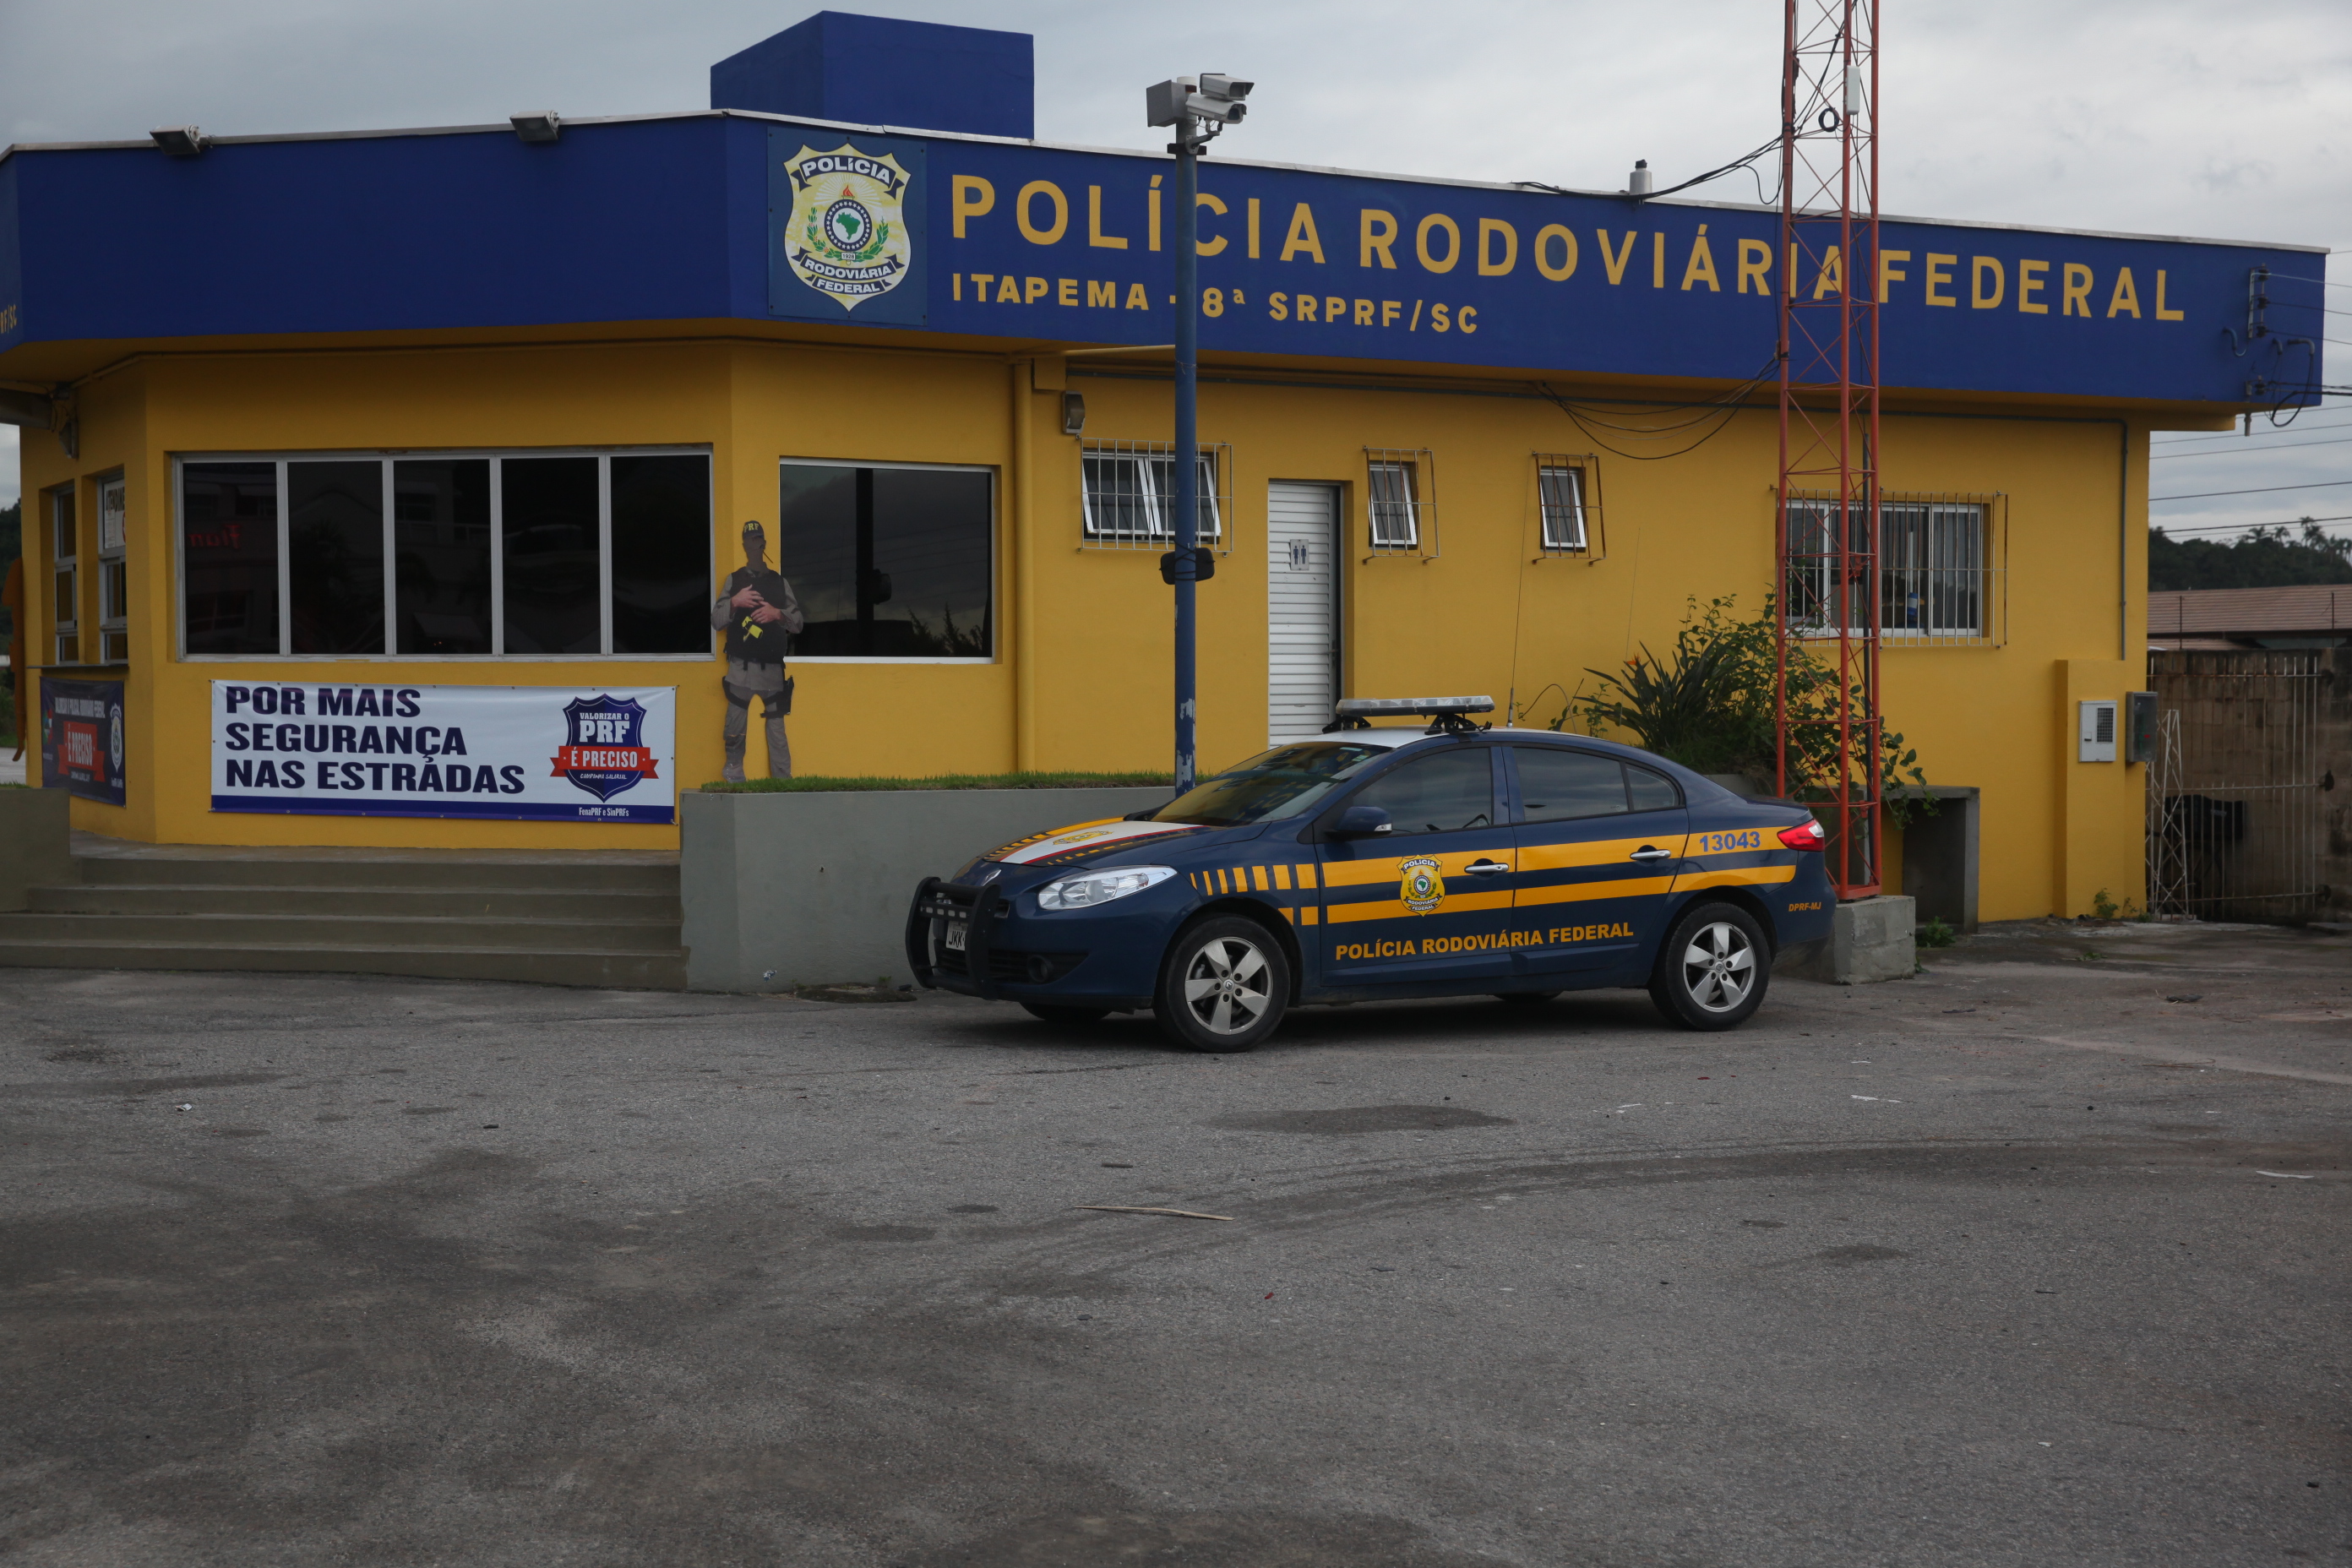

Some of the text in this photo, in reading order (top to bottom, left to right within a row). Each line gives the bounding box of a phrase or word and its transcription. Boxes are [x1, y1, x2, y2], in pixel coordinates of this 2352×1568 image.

[802, 157, 890, 184] POLÍCIA
[952, 174, 2185, 321] POLÍCIA RODOVIÁRIA FEDERAL
[805, 259, 892, 279] RODOVIÁRIA
[817, 279, 880, 294] FEDERAL
[952, 273, 1149, 310] ITAPEMA
[1269, 291, 1478, 334] SRPRF/SC
[743, 522, 760, 533] PRF
[226, 685, 421, 718] POR MAIS
[226, 721, 467, 763] SEGURANÇA
[580, 720, 630, 743] PRF
[72, 731, 93, 766] PRECISO
[571, 747, 638, 768] É PRECISO
[226, 759, 525, 795] NAS ESTRADAS
[579, 807, 602, 816] FenaPRF
[607, 808, 629, 817] SinPRFs
[1700, 831, 1761, 852] 13043
[1403, 859, 1435, 869] POLÍCIA
[1788, 901, 1822, 912] DPRF-MJ
[1336, 923, 1634, 960] POLÍCIA RODOVIÁRIA FEDERAL
